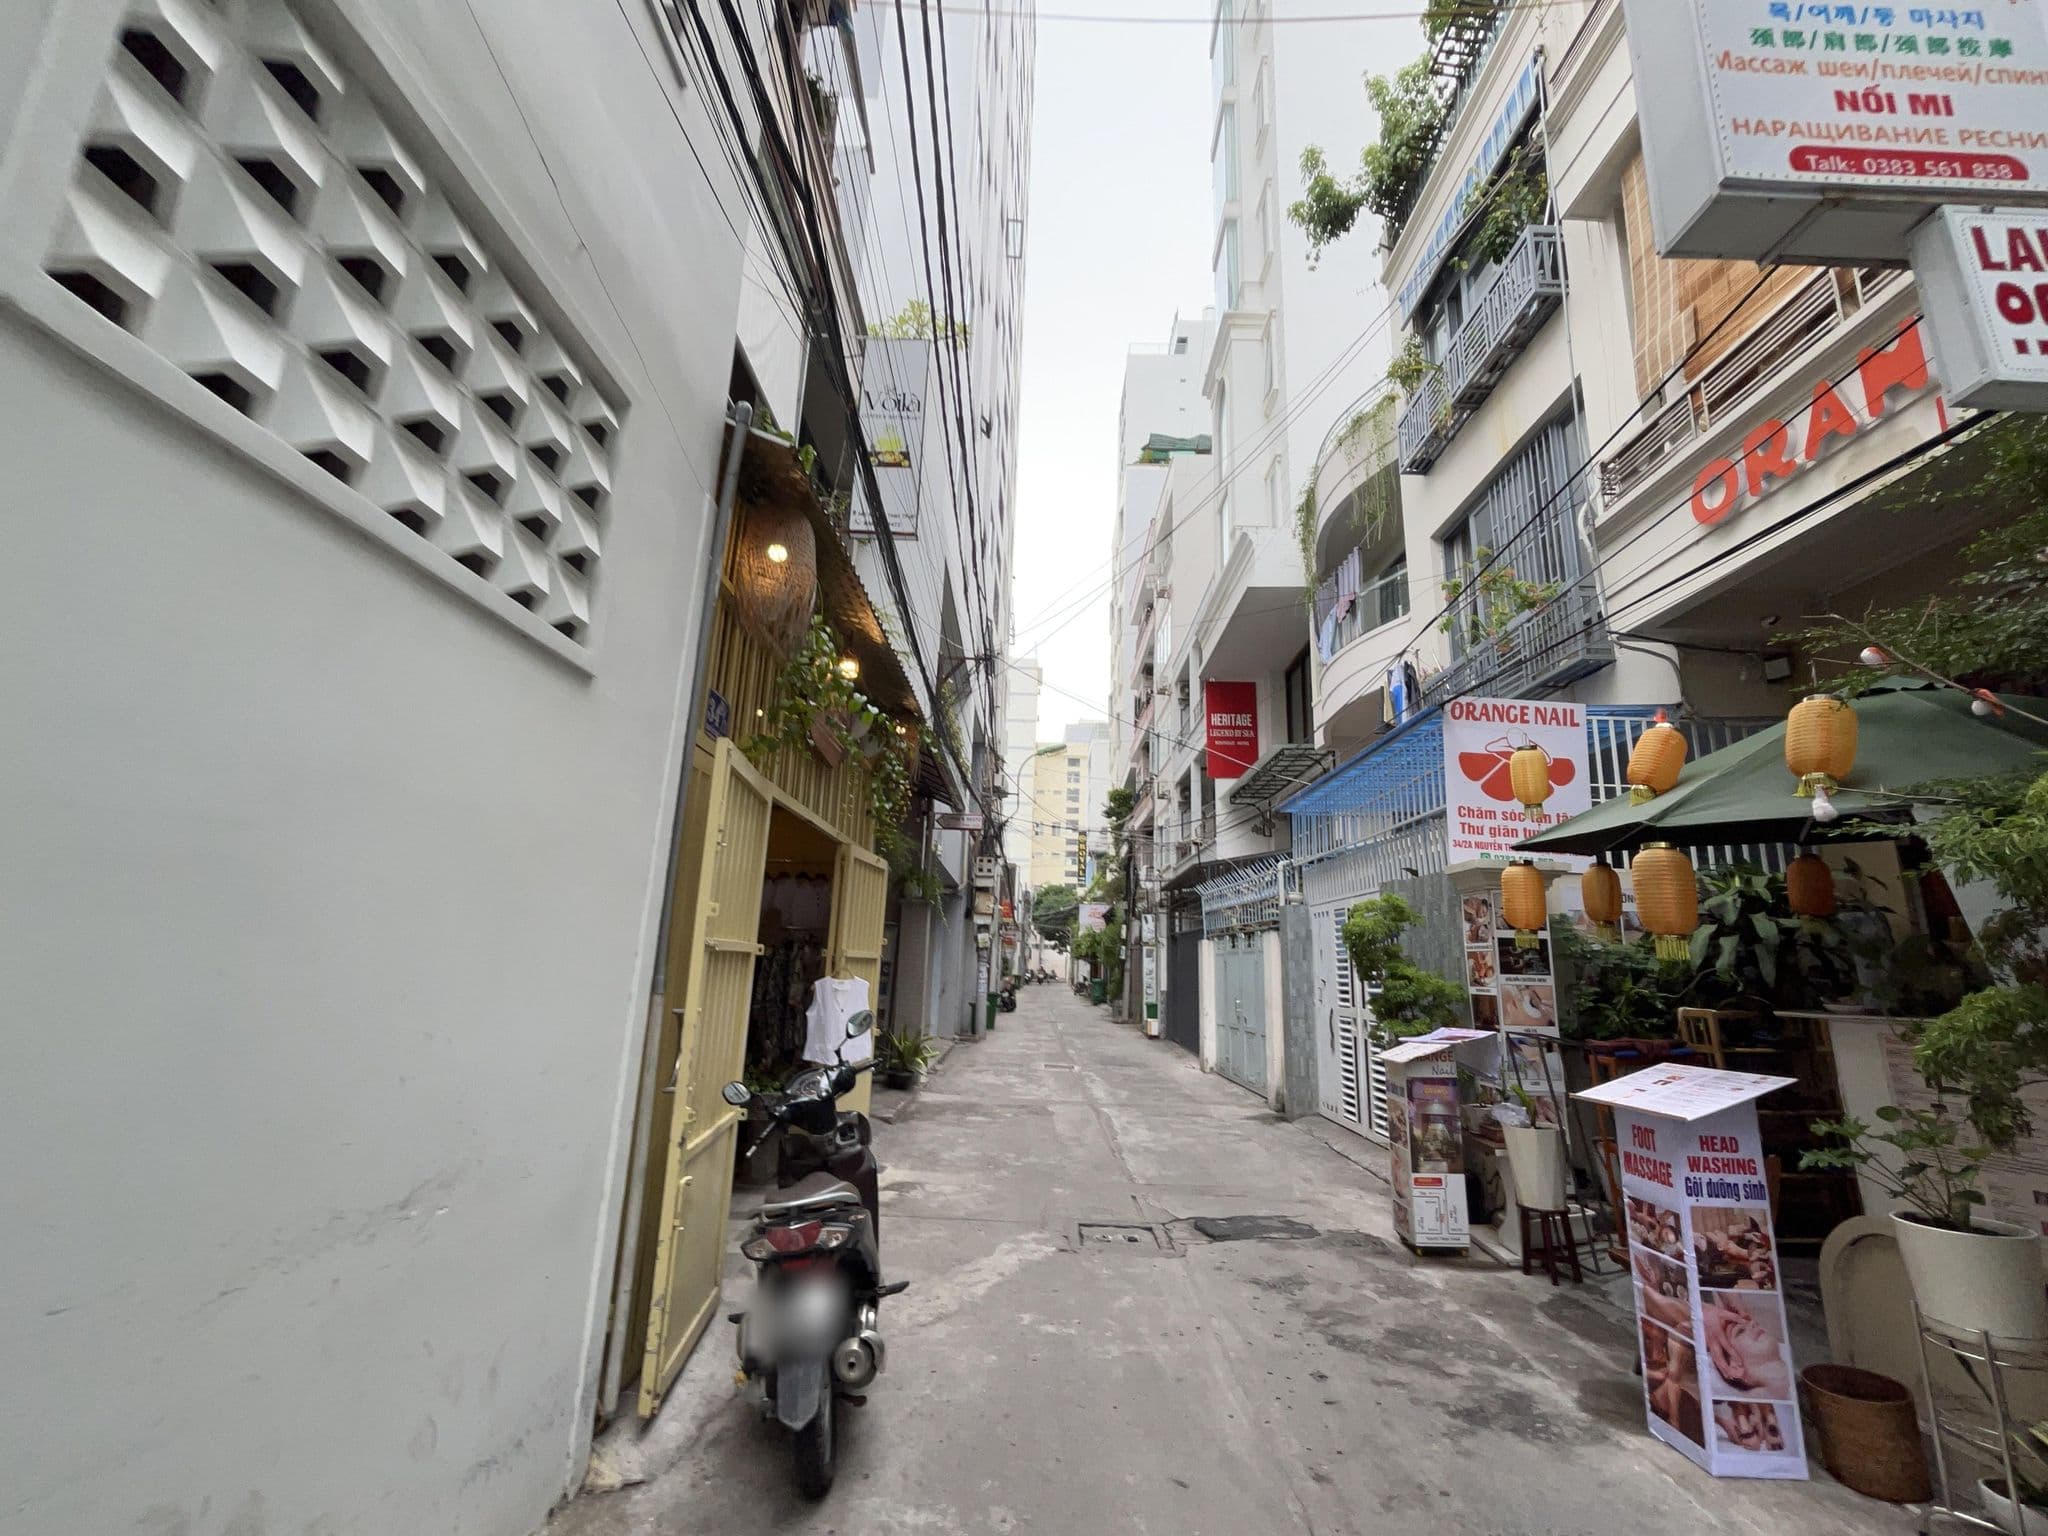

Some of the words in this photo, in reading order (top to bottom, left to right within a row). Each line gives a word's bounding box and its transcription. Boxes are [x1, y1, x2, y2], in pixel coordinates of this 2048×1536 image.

[1909, 8, 1985, 30] 마사지
[1716, 49, 1806, 75] Массаж
[1818, 58, 2048, 86] шеи/плечей/спин
[1833, 84, 1897, 114] NỐI
[1908, 93, 1954, 116] MI
[1732, 117, 1949, 145] НАРАЩИВАНИЕ
[1805, 154, 1857, 172] Talk:
[1863, 157, 1917, 175] 0383
[1924, 160, 1962, 177] 561
[1972, 162, 2013, 179] 858
[1211, 713, 1252, 726] HERITAGE
[1450, 701, 1529, 724] ORANGE
[1535, 706, 1580, 727] NAIL
[1457, 805, 1497, 820] Chăm
[1631, 1124, 1657, 1152] FOOT
[1698, 1135, 1739, 1153] HEAD
[1623, 1150, 1674, 1188] MASSAGE
[1686, 1155, 1758, 1176] WASHING
[1743, 1180, 1767, 1200] sinh
